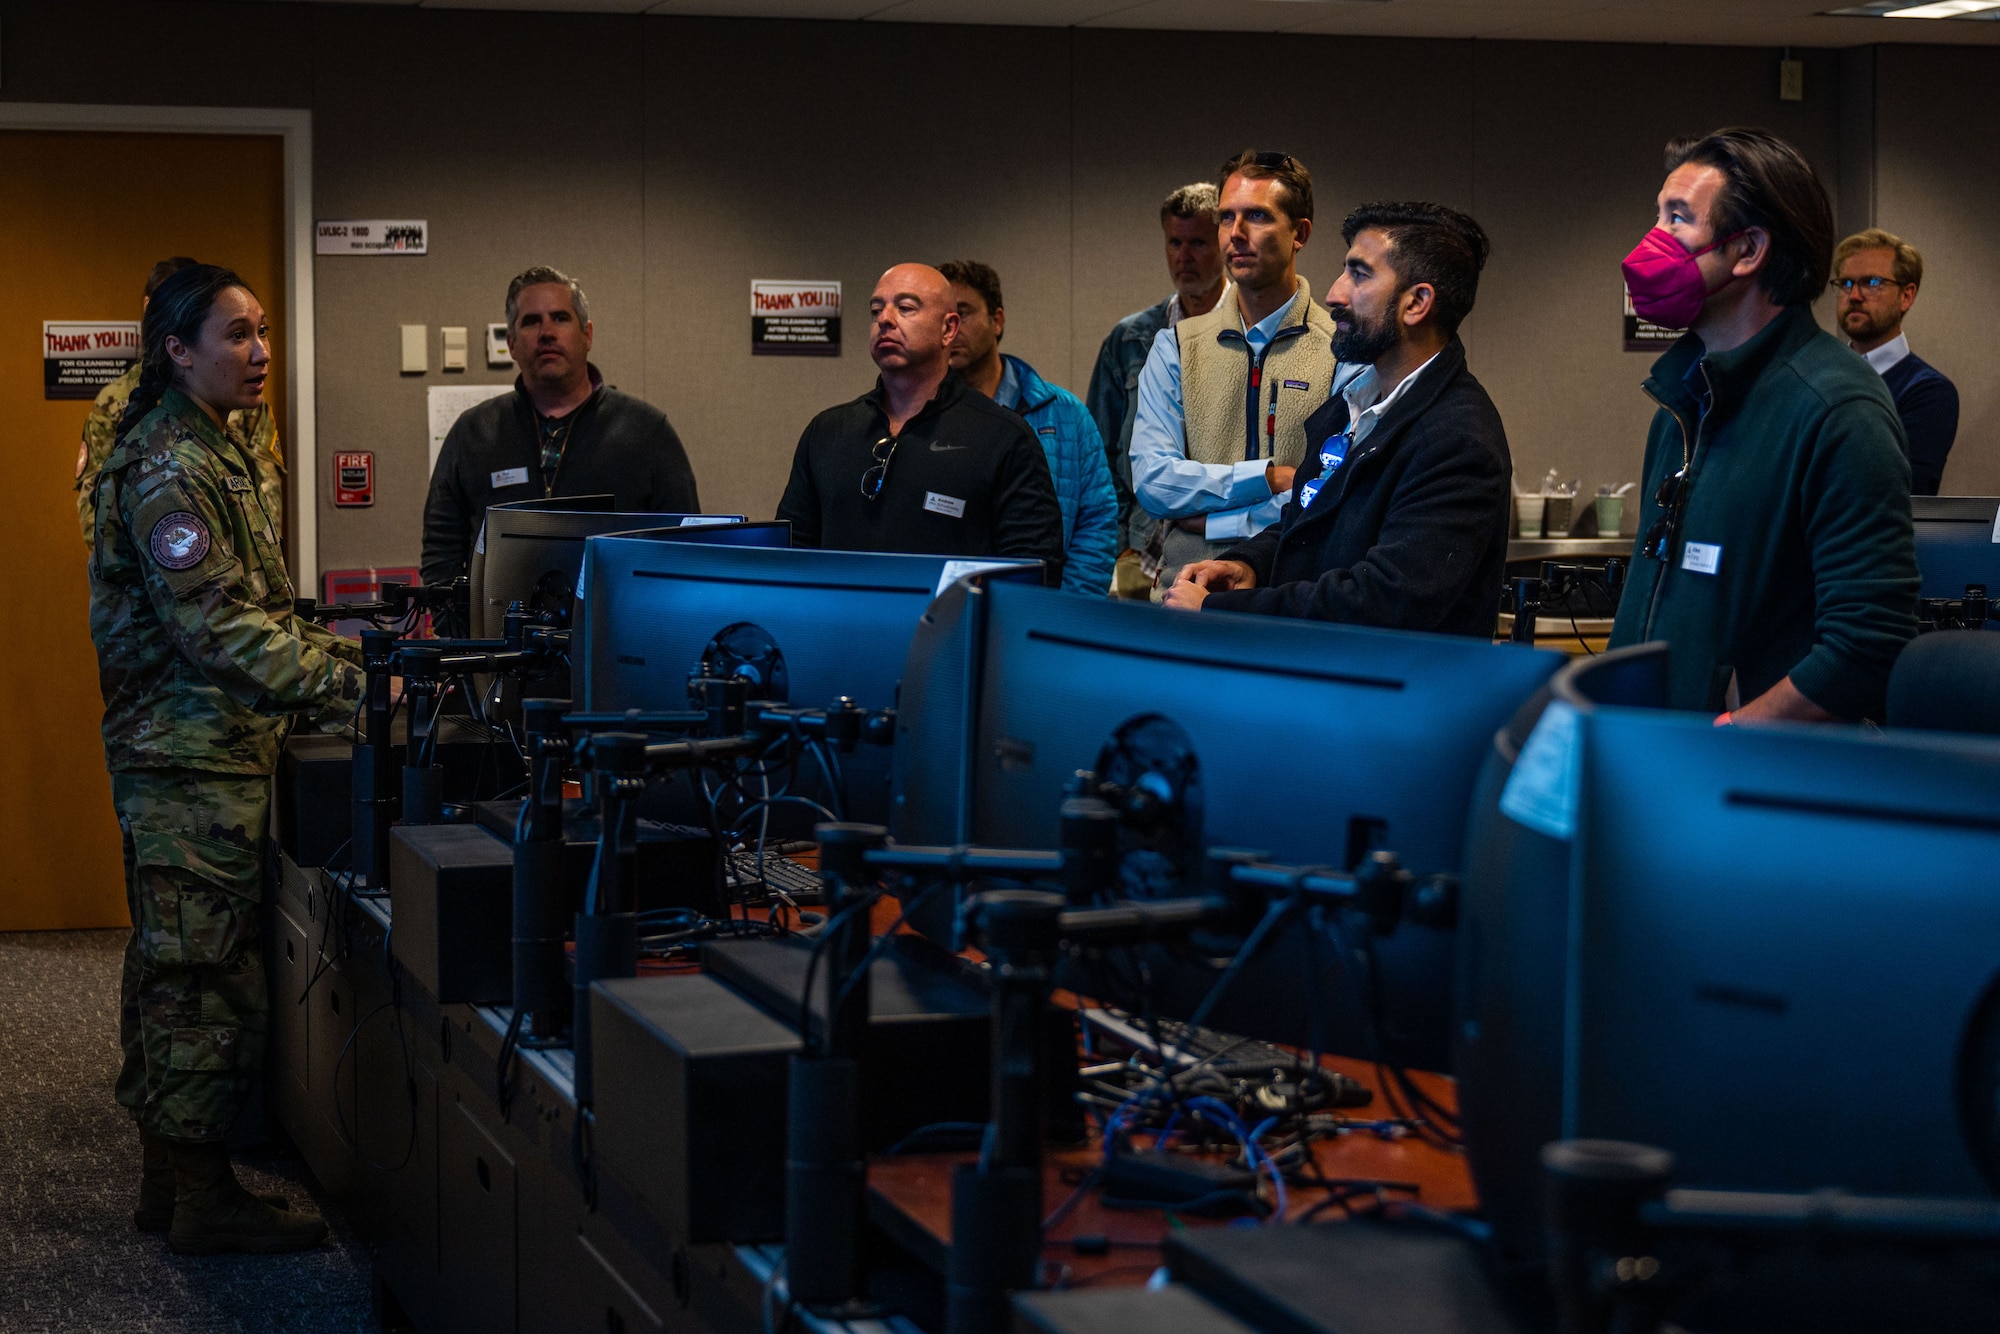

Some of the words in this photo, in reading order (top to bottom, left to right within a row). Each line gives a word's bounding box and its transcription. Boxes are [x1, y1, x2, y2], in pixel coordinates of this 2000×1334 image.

[754, 291, 795, 310] THANK
[797, 291, 822, 308] YOU
[765, 318, 780, 326] FOR
[45, 332, 91, 352] THANK
[93, 331, 122, 349] YOU
[58, 360, 76, 368] FOR
[76, 360, 115, 368] CLEANING
[115, 360, 127, 368] UP
[62, 368, 86, 376] AFTER
[58, 376, 84, 385] PRIOR
[84, 376, 95, 385] TO
[339, 455, 369, 467] FIRE
